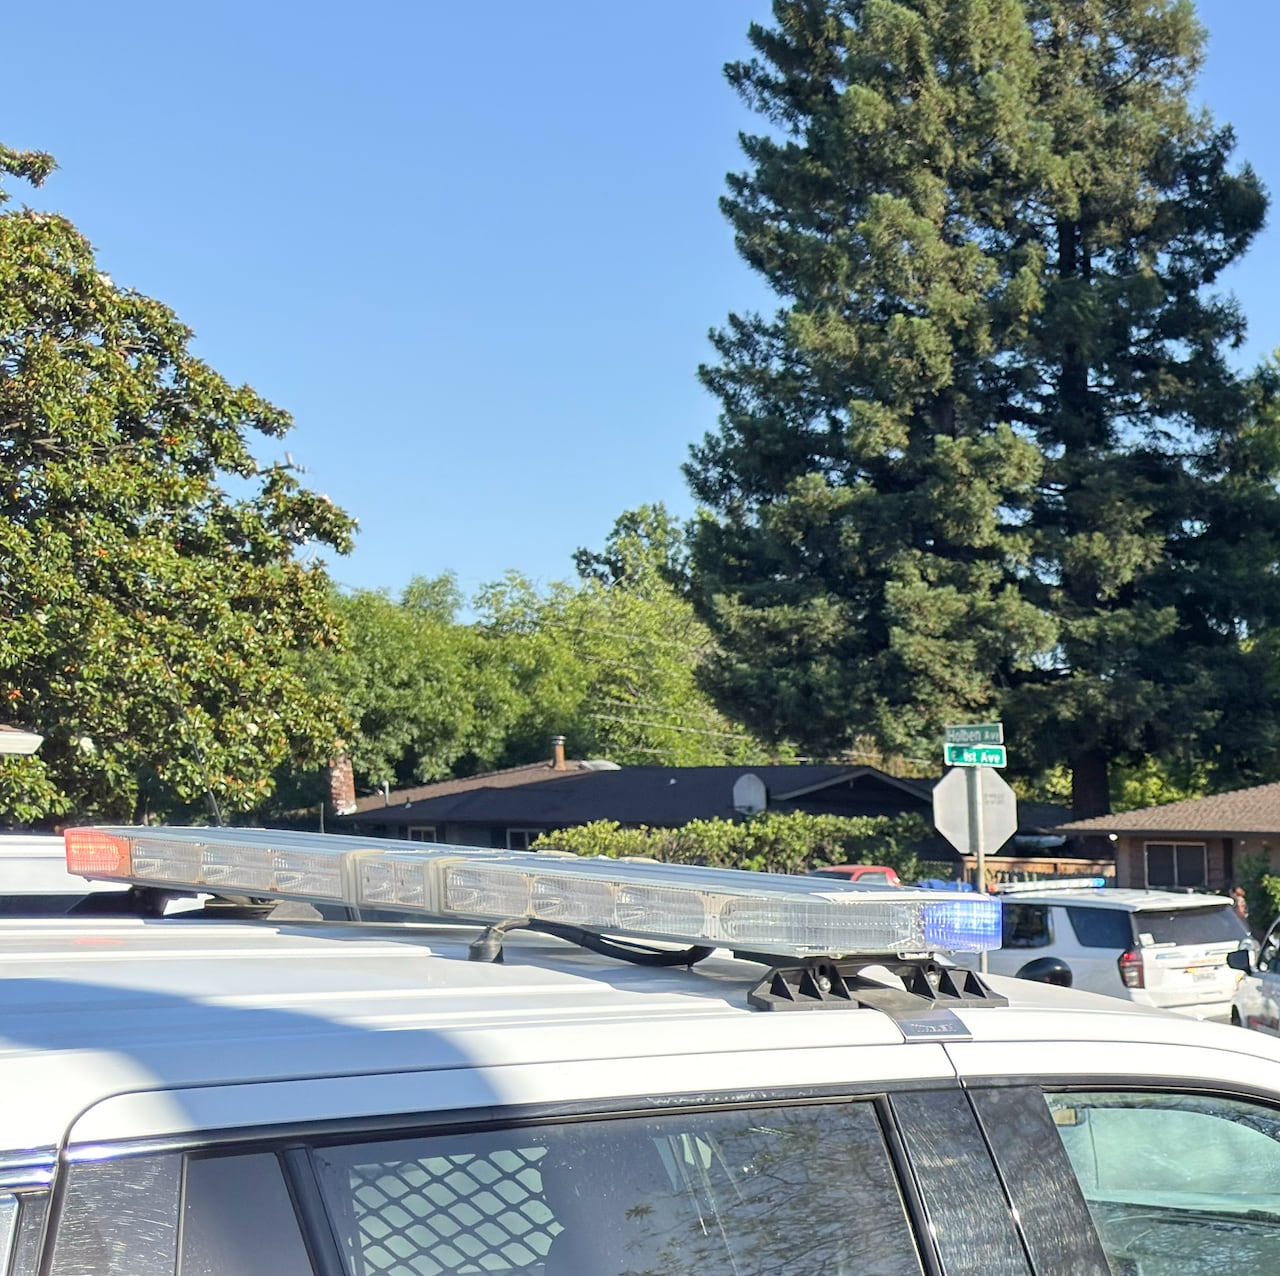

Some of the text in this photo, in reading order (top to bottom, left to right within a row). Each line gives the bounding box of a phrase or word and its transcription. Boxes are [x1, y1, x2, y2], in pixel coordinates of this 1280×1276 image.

[984, 731, 1000, 741] Ave
[963, 749, 976, 762] 1st
[980, 751, 1000, 763] Ave
